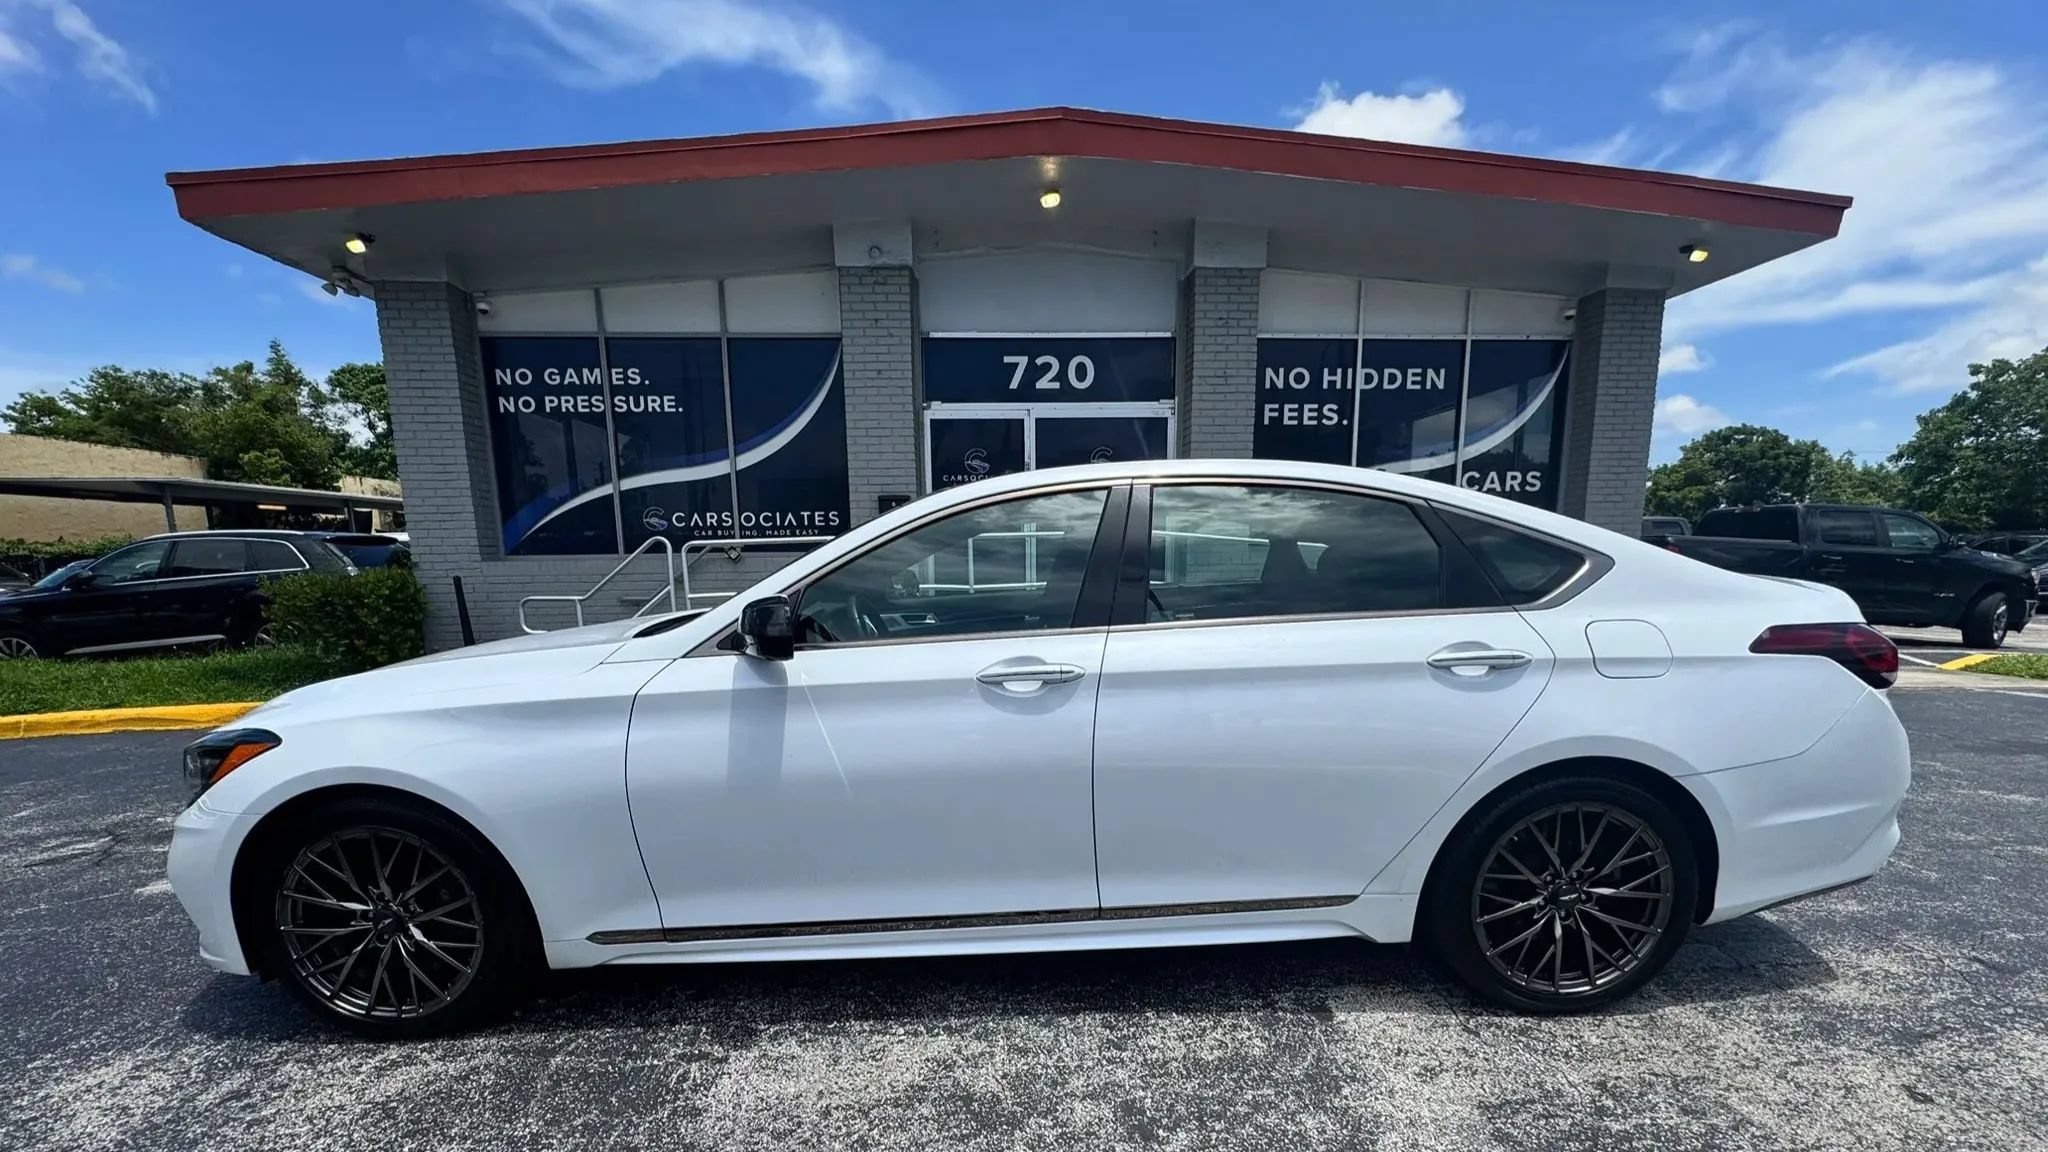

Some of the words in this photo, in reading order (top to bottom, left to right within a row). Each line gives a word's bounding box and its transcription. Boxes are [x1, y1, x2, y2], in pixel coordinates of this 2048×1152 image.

[495, 368, 533, 385] NO
[544, 368, 650, 385] GAMES.
[1003, 355, 1096, 390] 720
[1264, 367, 1311, 390] NO
[1322, 367, 1447, 390] HIDDEN
[498, 396, 536, 413] NO
[544, 395, 684, 413] PRESSURE.
[1263, 403, 1349, 426] FEES.
[1461, 470, 1542, 492] CARS
[672, 511, 840, 527] CARSOCIATES
[694, 529, 713, 537] CAR
